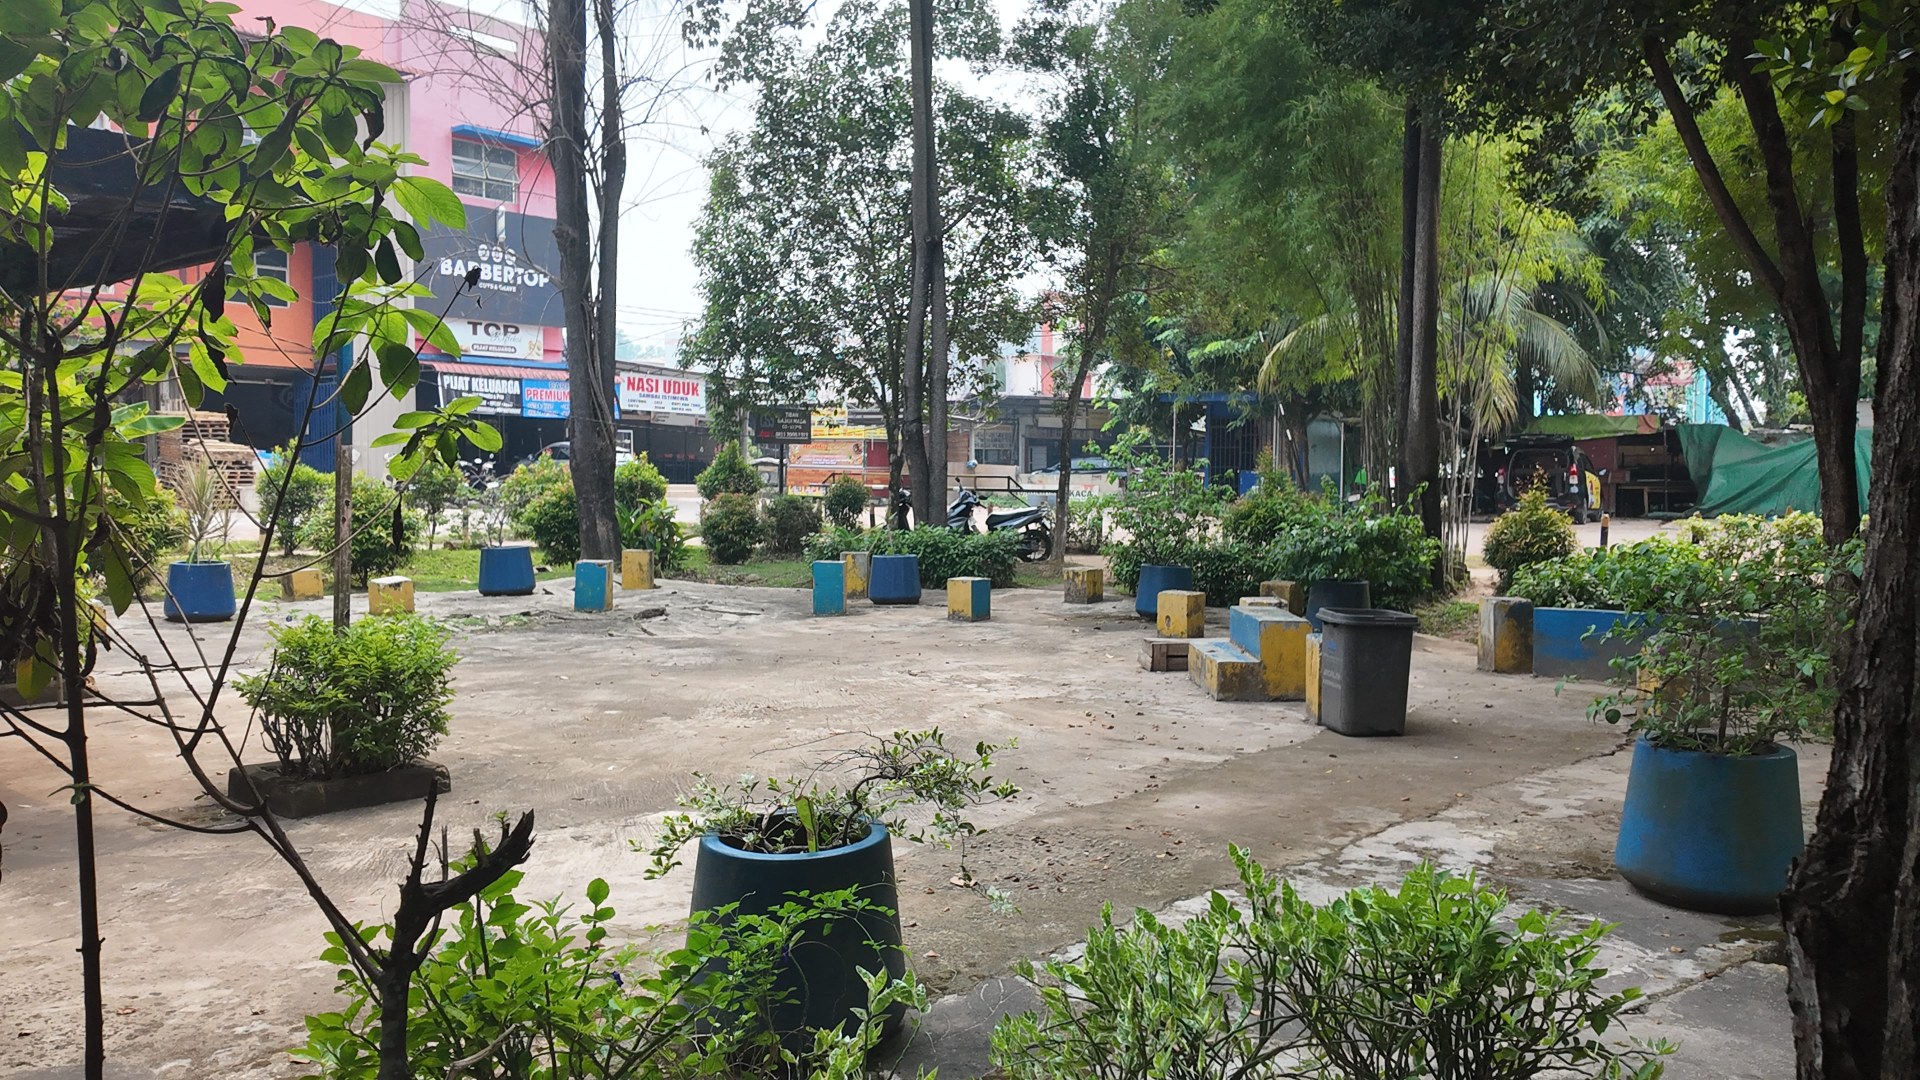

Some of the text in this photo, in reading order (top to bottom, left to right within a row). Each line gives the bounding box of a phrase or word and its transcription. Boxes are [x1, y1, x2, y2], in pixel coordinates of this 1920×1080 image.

[467, 321, 520, 337] TOP
[443, 375, 520, 394] PIJAT KELUARGA
[627, 376, 699, 396] NASI UDUK
[525, 388, 570, 401] PREMIUM
